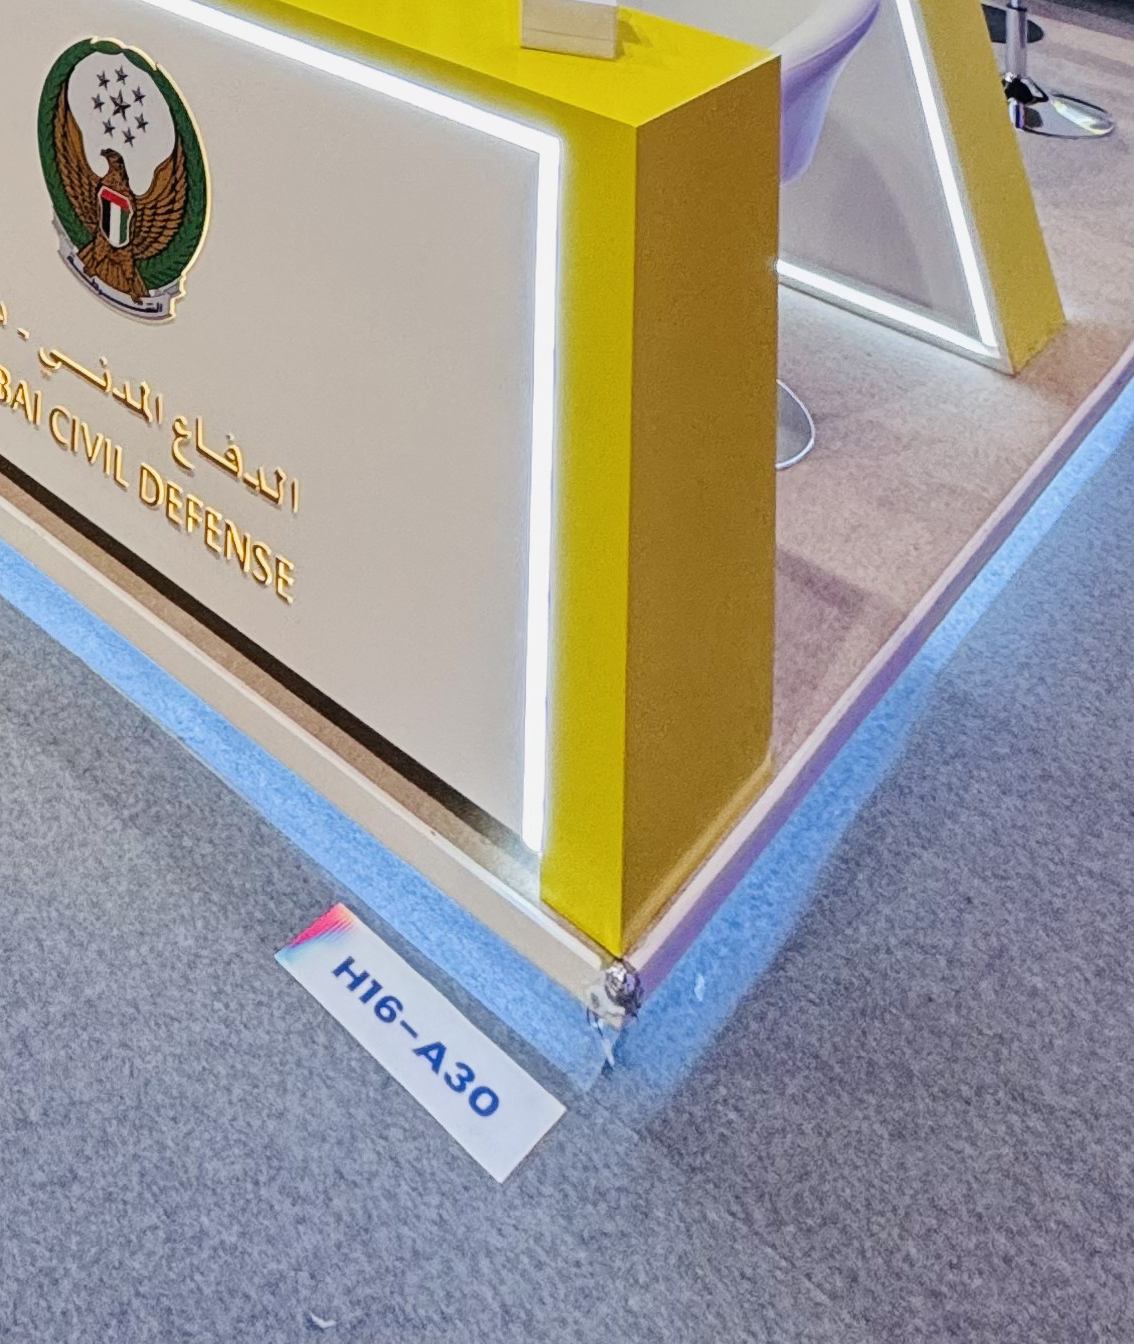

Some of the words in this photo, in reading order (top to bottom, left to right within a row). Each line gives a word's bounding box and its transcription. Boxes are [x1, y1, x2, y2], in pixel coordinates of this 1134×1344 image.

[36, 343, 164, 425] المدني
[49, 404, 129, 489] CIVIL
[139, 462, 296, 604] DEFENSE
[172, 415, 300, 514] الدفاع
[331, 955, 501, 1118] H16-A30
